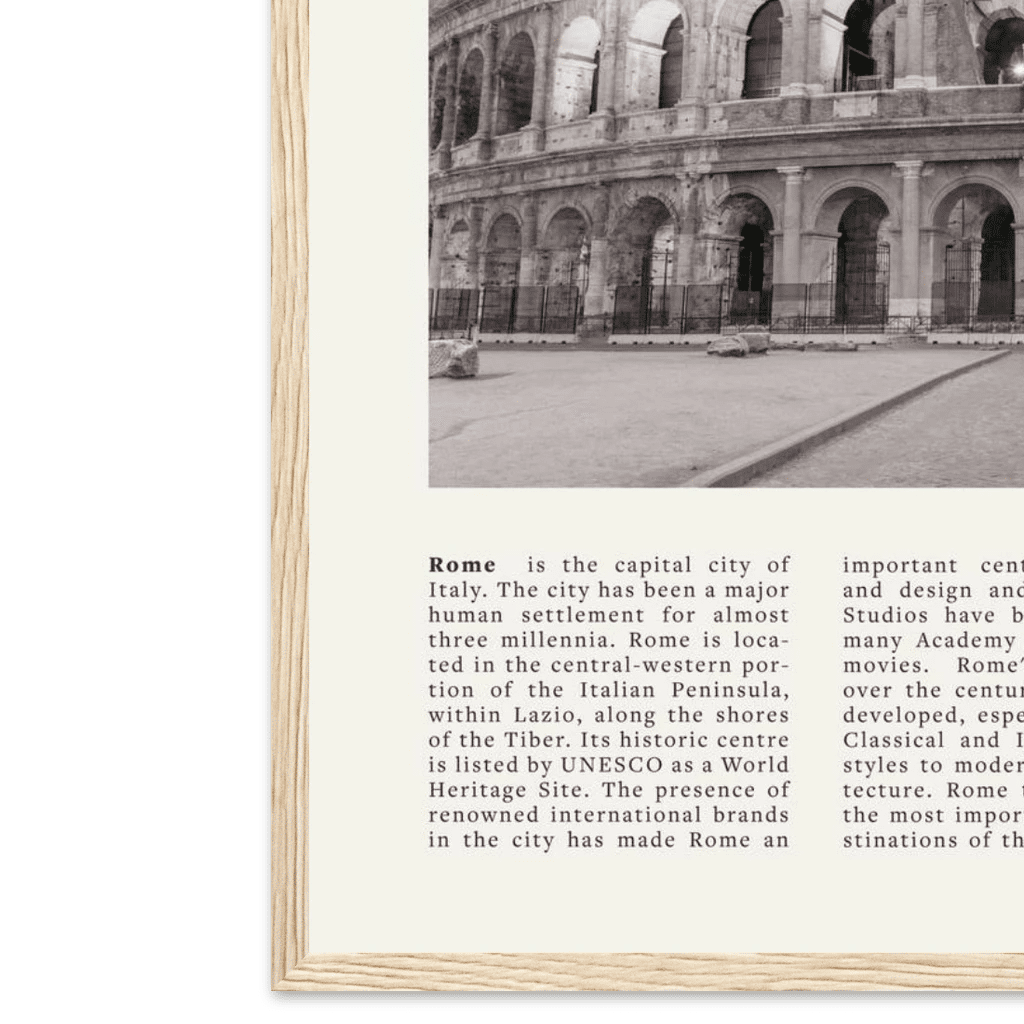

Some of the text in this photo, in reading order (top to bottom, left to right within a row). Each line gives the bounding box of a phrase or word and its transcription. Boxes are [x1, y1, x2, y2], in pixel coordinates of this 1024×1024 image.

[429, 555, 791, 579] Rome is the capital city of
[843, 556, 957, 579] important
[843, 580, 882, 598] and
[899, 580, 972, 604] design
[428, 605, 789, 623] human settlement for almost
[428, 630, 788, 648] three millennia. Rome is loca-
[428, 655, 789, 679] ted in the central-western por-
[428, 680, 789, 701] tion of the Italian Peninsula,
[843, 685, 892, 699] over
[905, 680, 941, 699] the
[428, 705, 789, 729] within Lazio, along the shores
[843, 705, 965, 729] developed,
[428, 730, 789, 748] of the Tiber. Its historic centre
[843, 730, 944, 748] Classical
[960, 730, 1000, 748] and
[843, 755, 908, 779] styles
[920, 759, 943, 774] to
[429, 780, 791, 808] Heritage Site. The presence of
[843, 784, 932, 798] tecture.
[947, 782, 1008, 798] Rome
[429, 805, 789, 823] renowned international brands
[843, 805, 879, 823] the
[890, 809, 944, 823] most
[429, 830, 788, 854] in the city has made Rome an
[843, 831, 957, 848] stinations
[969, 830, 993, 848] of
